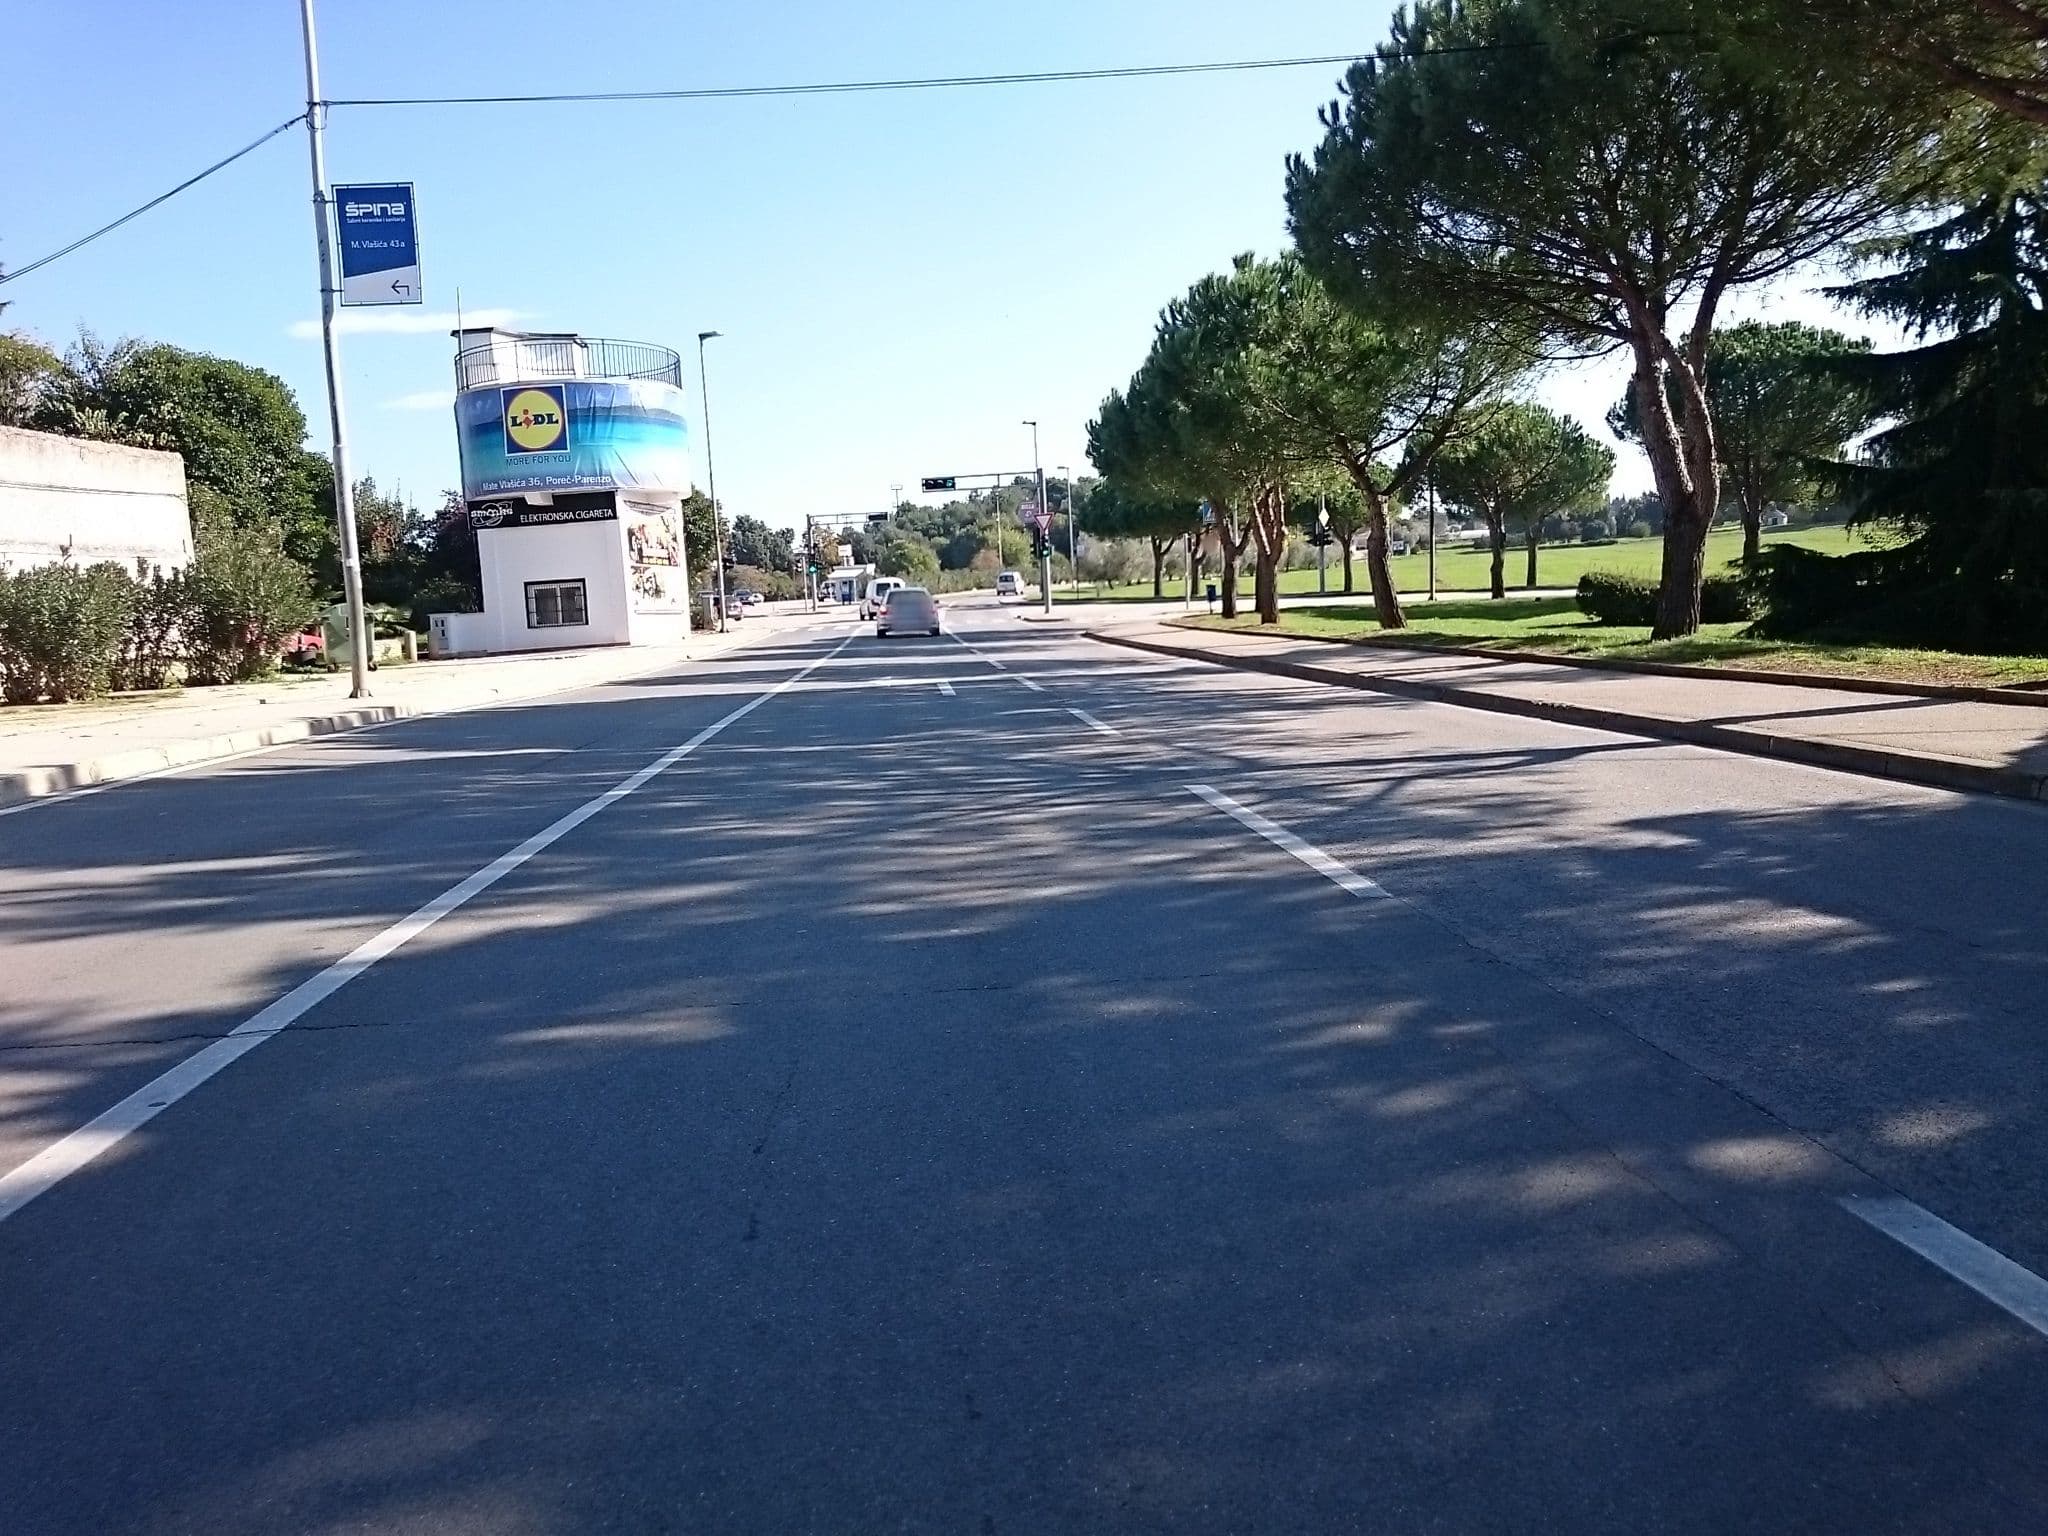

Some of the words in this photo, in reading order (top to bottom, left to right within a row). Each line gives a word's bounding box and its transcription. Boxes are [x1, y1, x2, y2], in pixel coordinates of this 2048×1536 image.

[507, 456, 530, 466] MORE
[532, 455, 550, 463] FOR
[552, 454, 571, 462] YOU
[500, 479, 525, 489] Vlašića
[528, 477, 543, 487] 36,
[546, 475, 611, 485] Poreč-Parenzo
[520, 511, 574, 523] ELEKTRONSKA
[575, 509, 613, 519] CIGARETA
